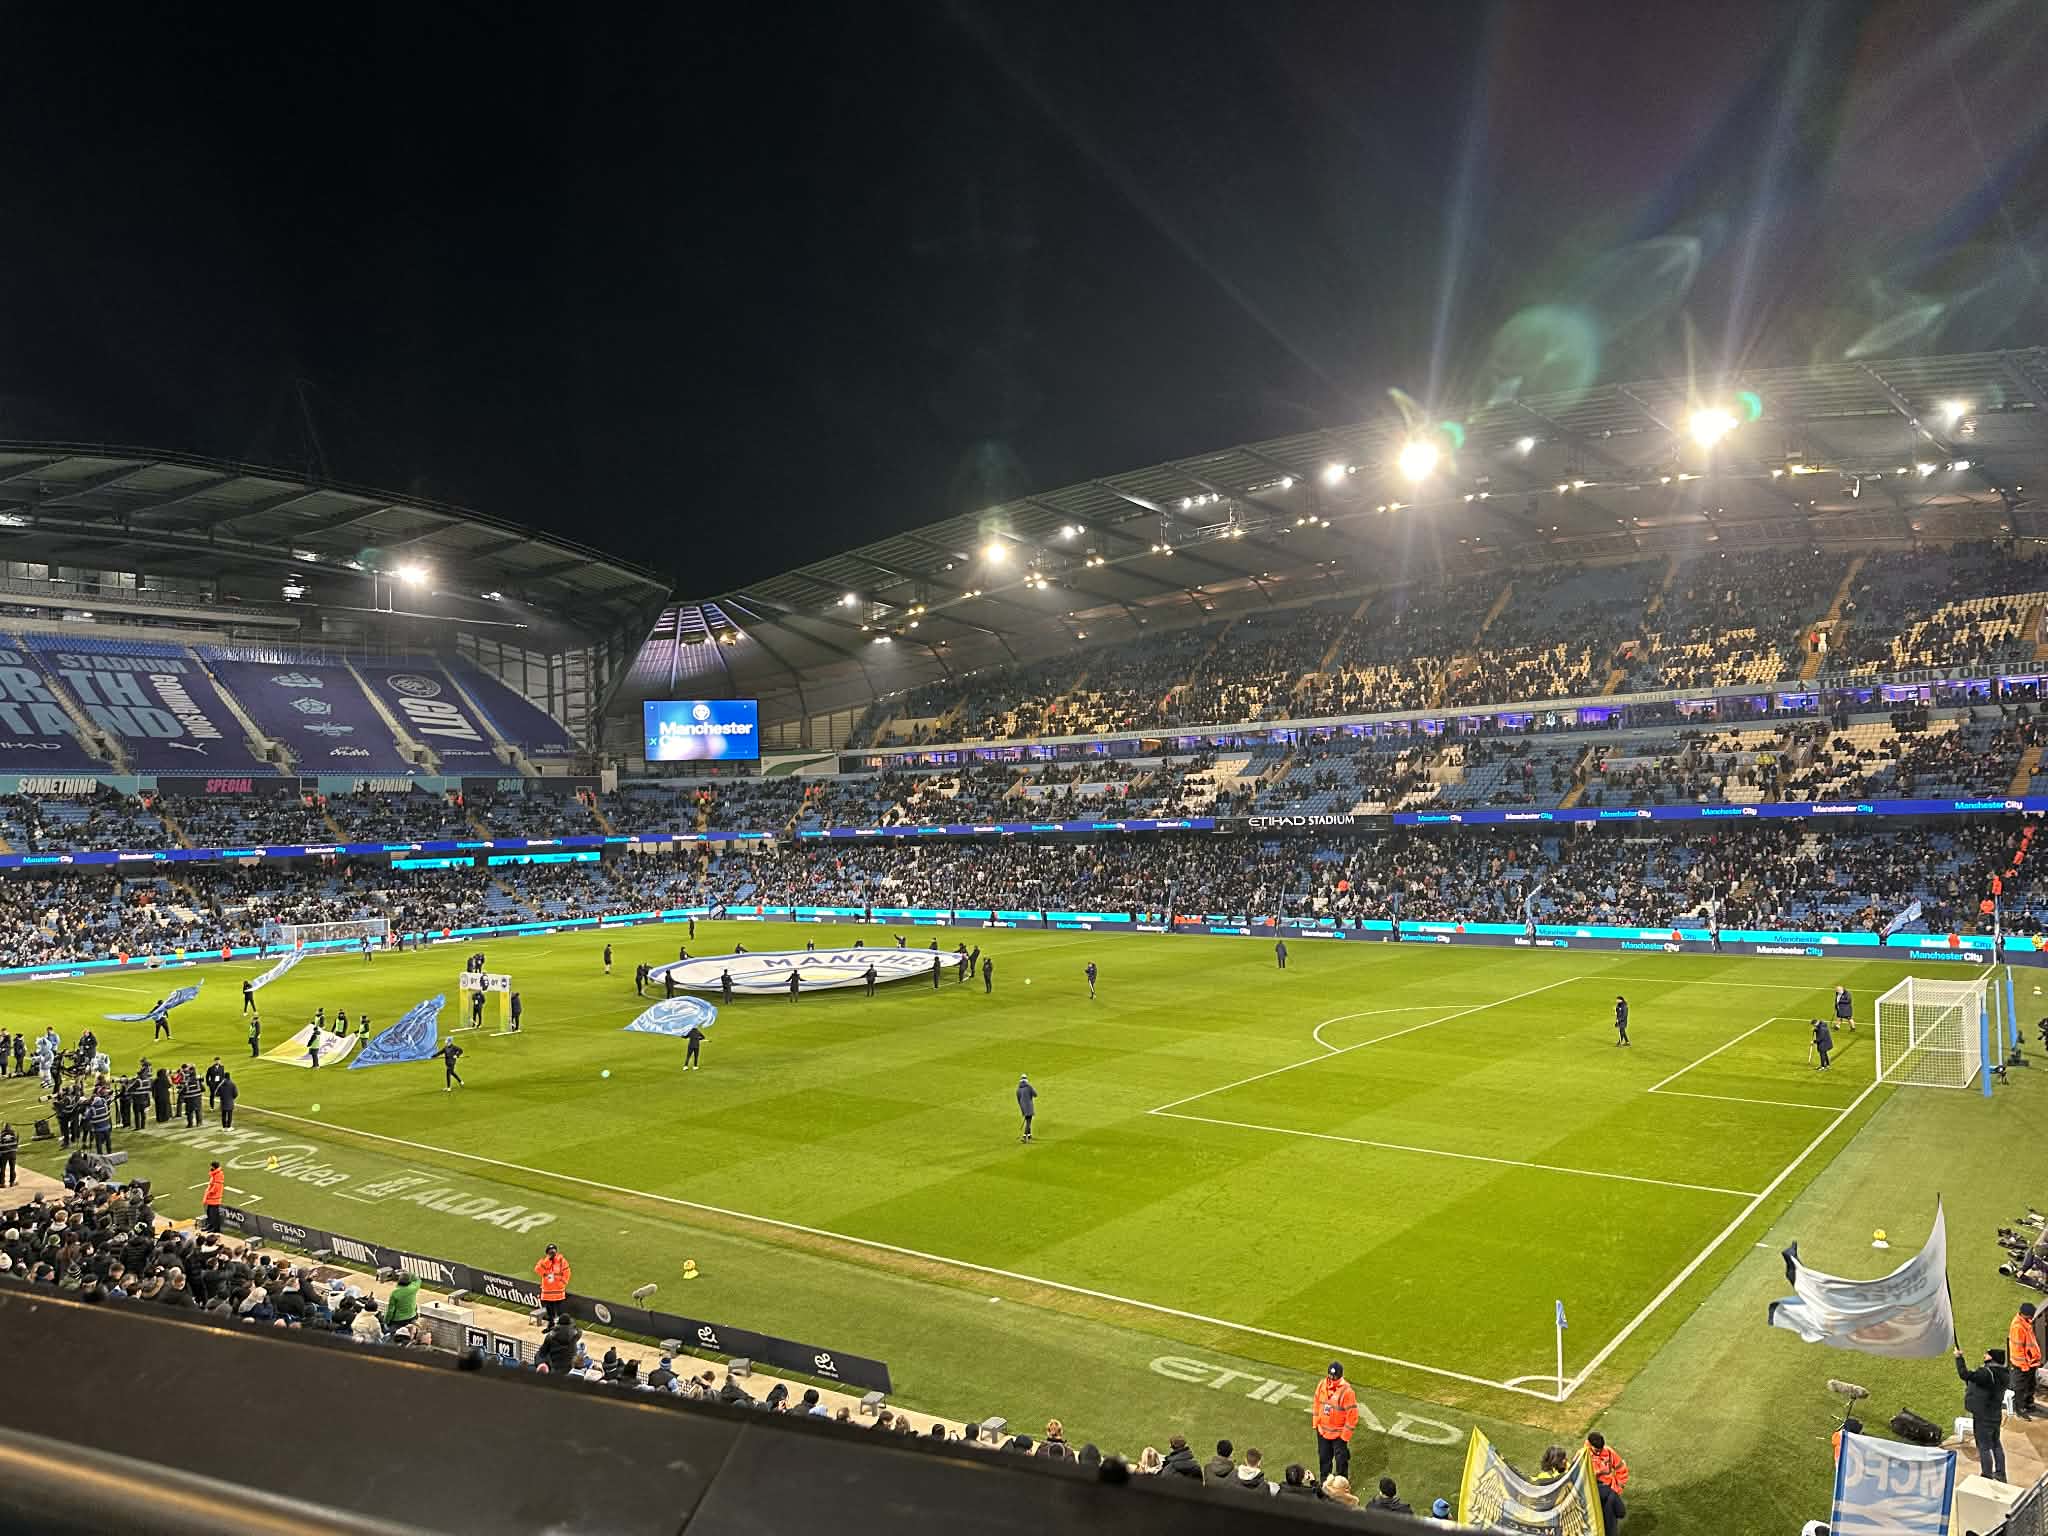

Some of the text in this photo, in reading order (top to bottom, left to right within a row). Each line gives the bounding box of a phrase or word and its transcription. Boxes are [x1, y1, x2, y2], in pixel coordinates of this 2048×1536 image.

[55, 654, 189, 674] STADIUM
[1902, 669, 1952, 683] ONLY
[1959, 663, 2000, 677] ONE
[2004, 661, 2048, 675] RIC
[398, 697, 484, 742] CITY
[658, 721, 754, 736] Manchester
[17, 777, 98, 794] SOMETHING
[205, 778, 253, 793] SPECIAL
[352, 778, 413, 793] IS COMING
[1248, 815, 1355, 827] ETIHAD STADIUM
[402, 1187, 558, 1234] ALDAR
[272, 1222, 306, 1239] ETIHAD
[332, 1236, 368, 1263] PUMA
[485, 1283, 543, 1310] abu dhabi
